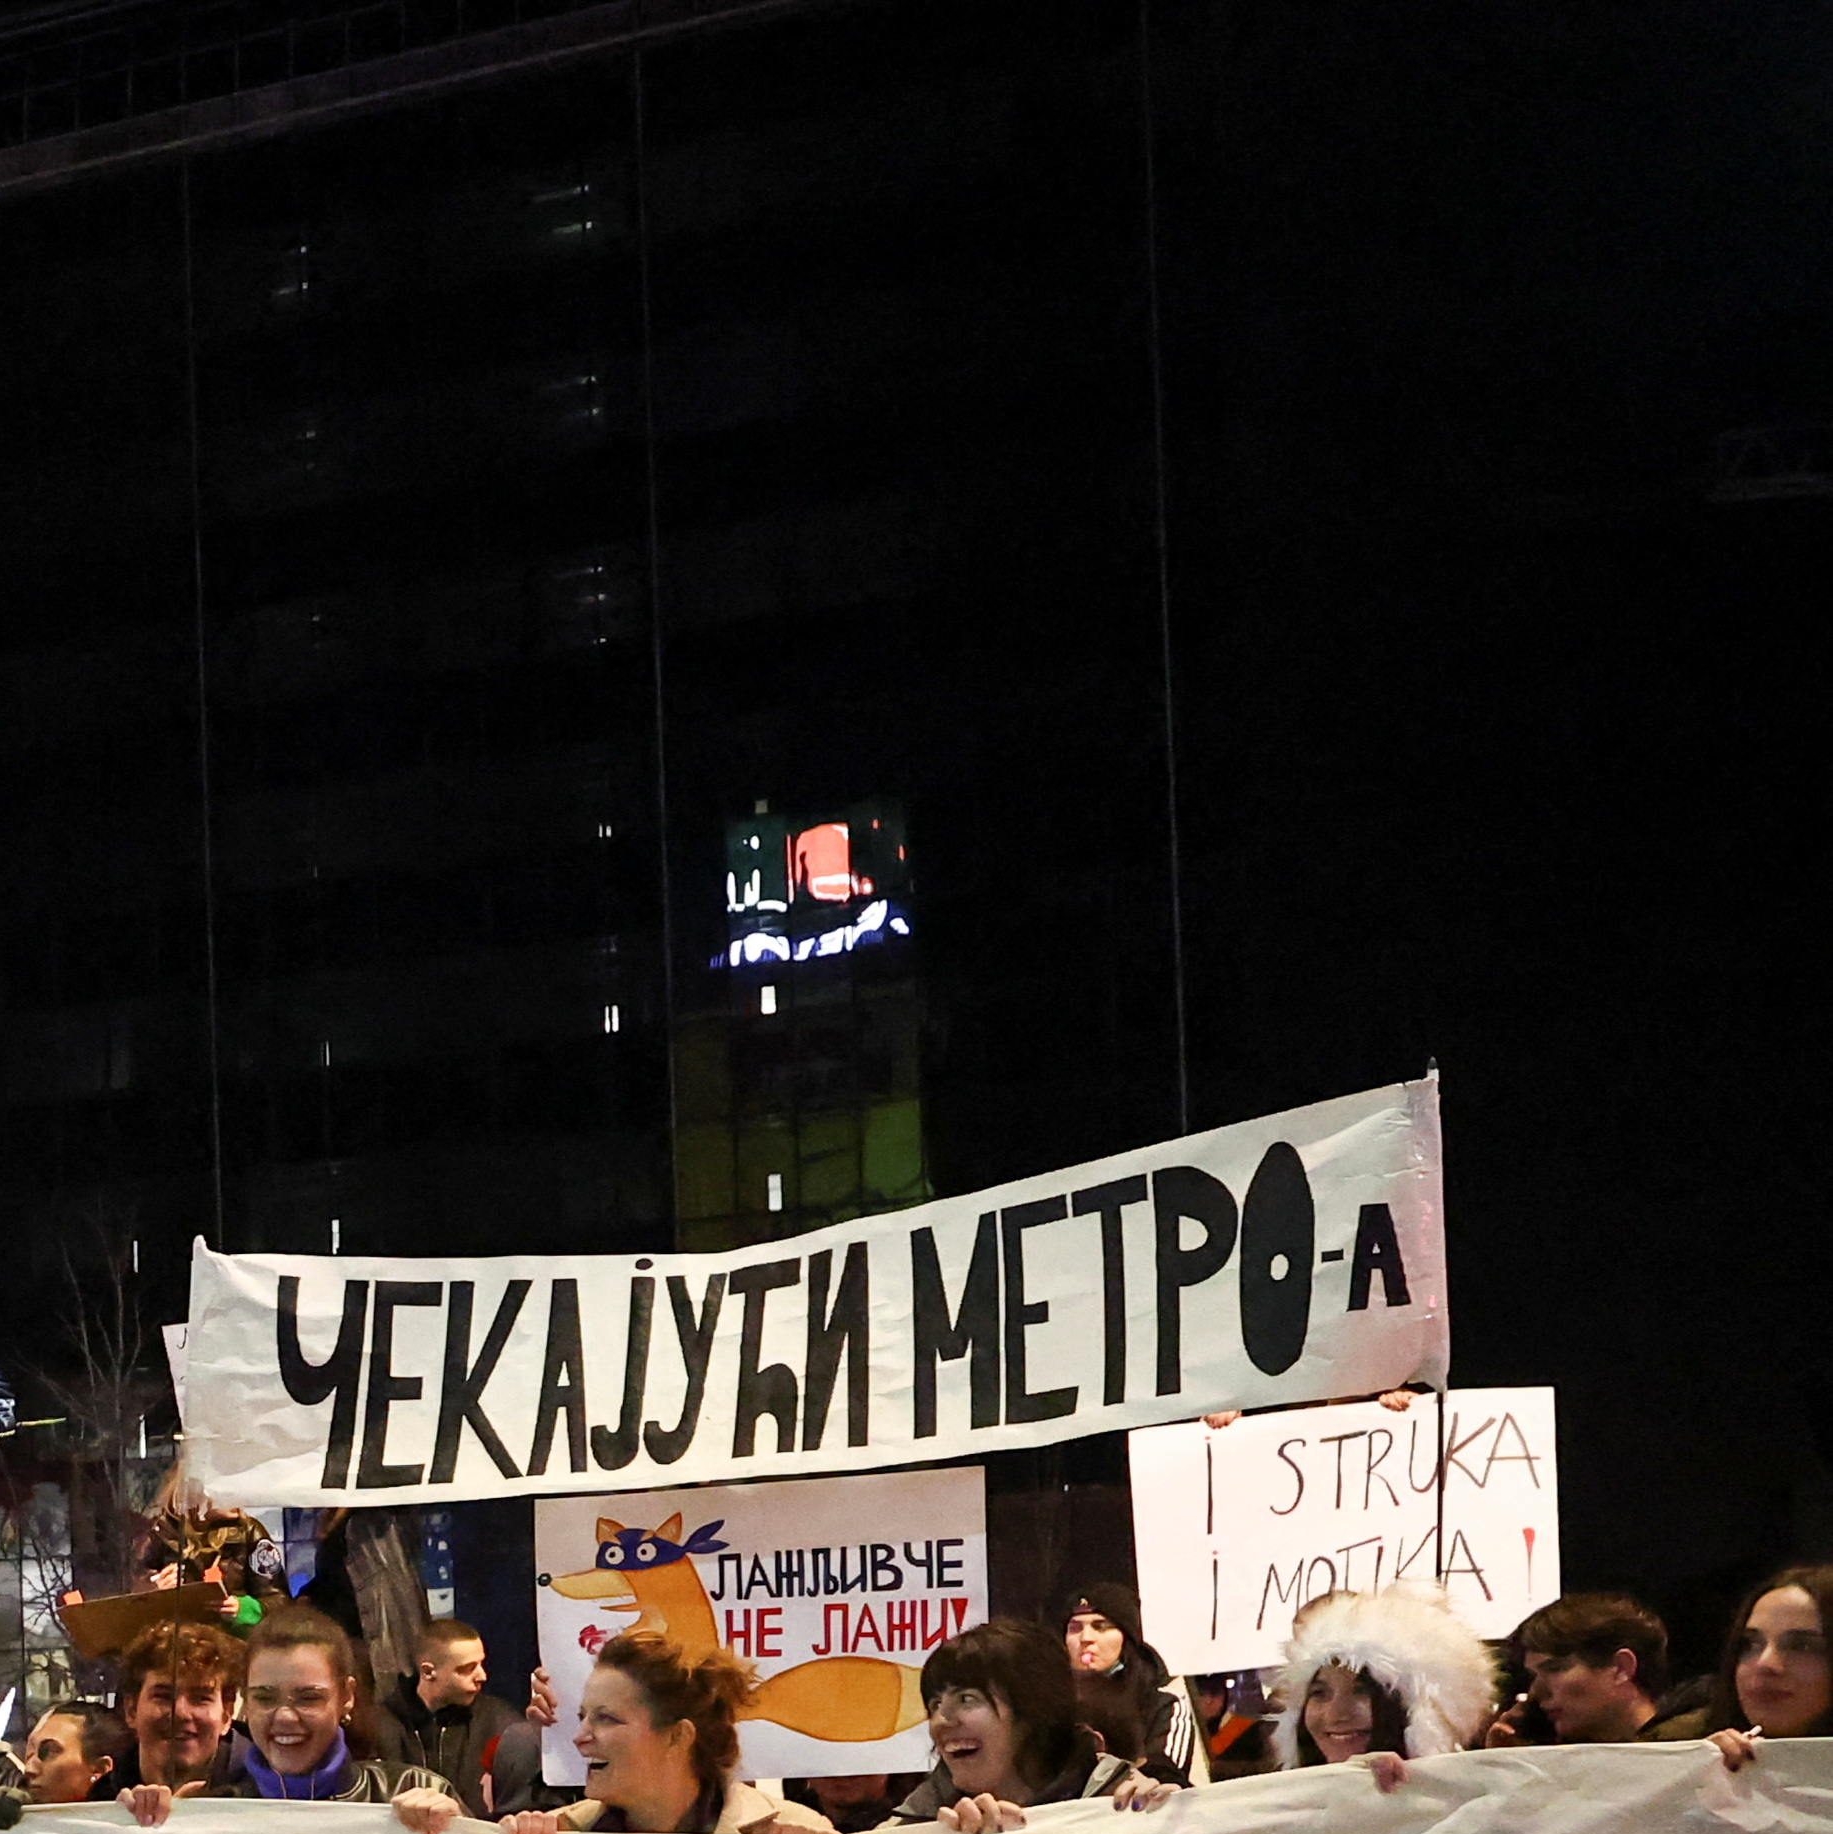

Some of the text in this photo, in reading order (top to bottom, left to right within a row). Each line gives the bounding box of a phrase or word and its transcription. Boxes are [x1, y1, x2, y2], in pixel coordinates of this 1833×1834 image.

[277, 1241, 871, 1490] ЧЕКАЈУЋИ
[1270, 1412, 1541, 1515] STRUKA
[710, 1538, 964, 1601] ЛАЖЉИВЧЕ
[725, 1598, 969, 1658] НЕ ЛАЖИ!
